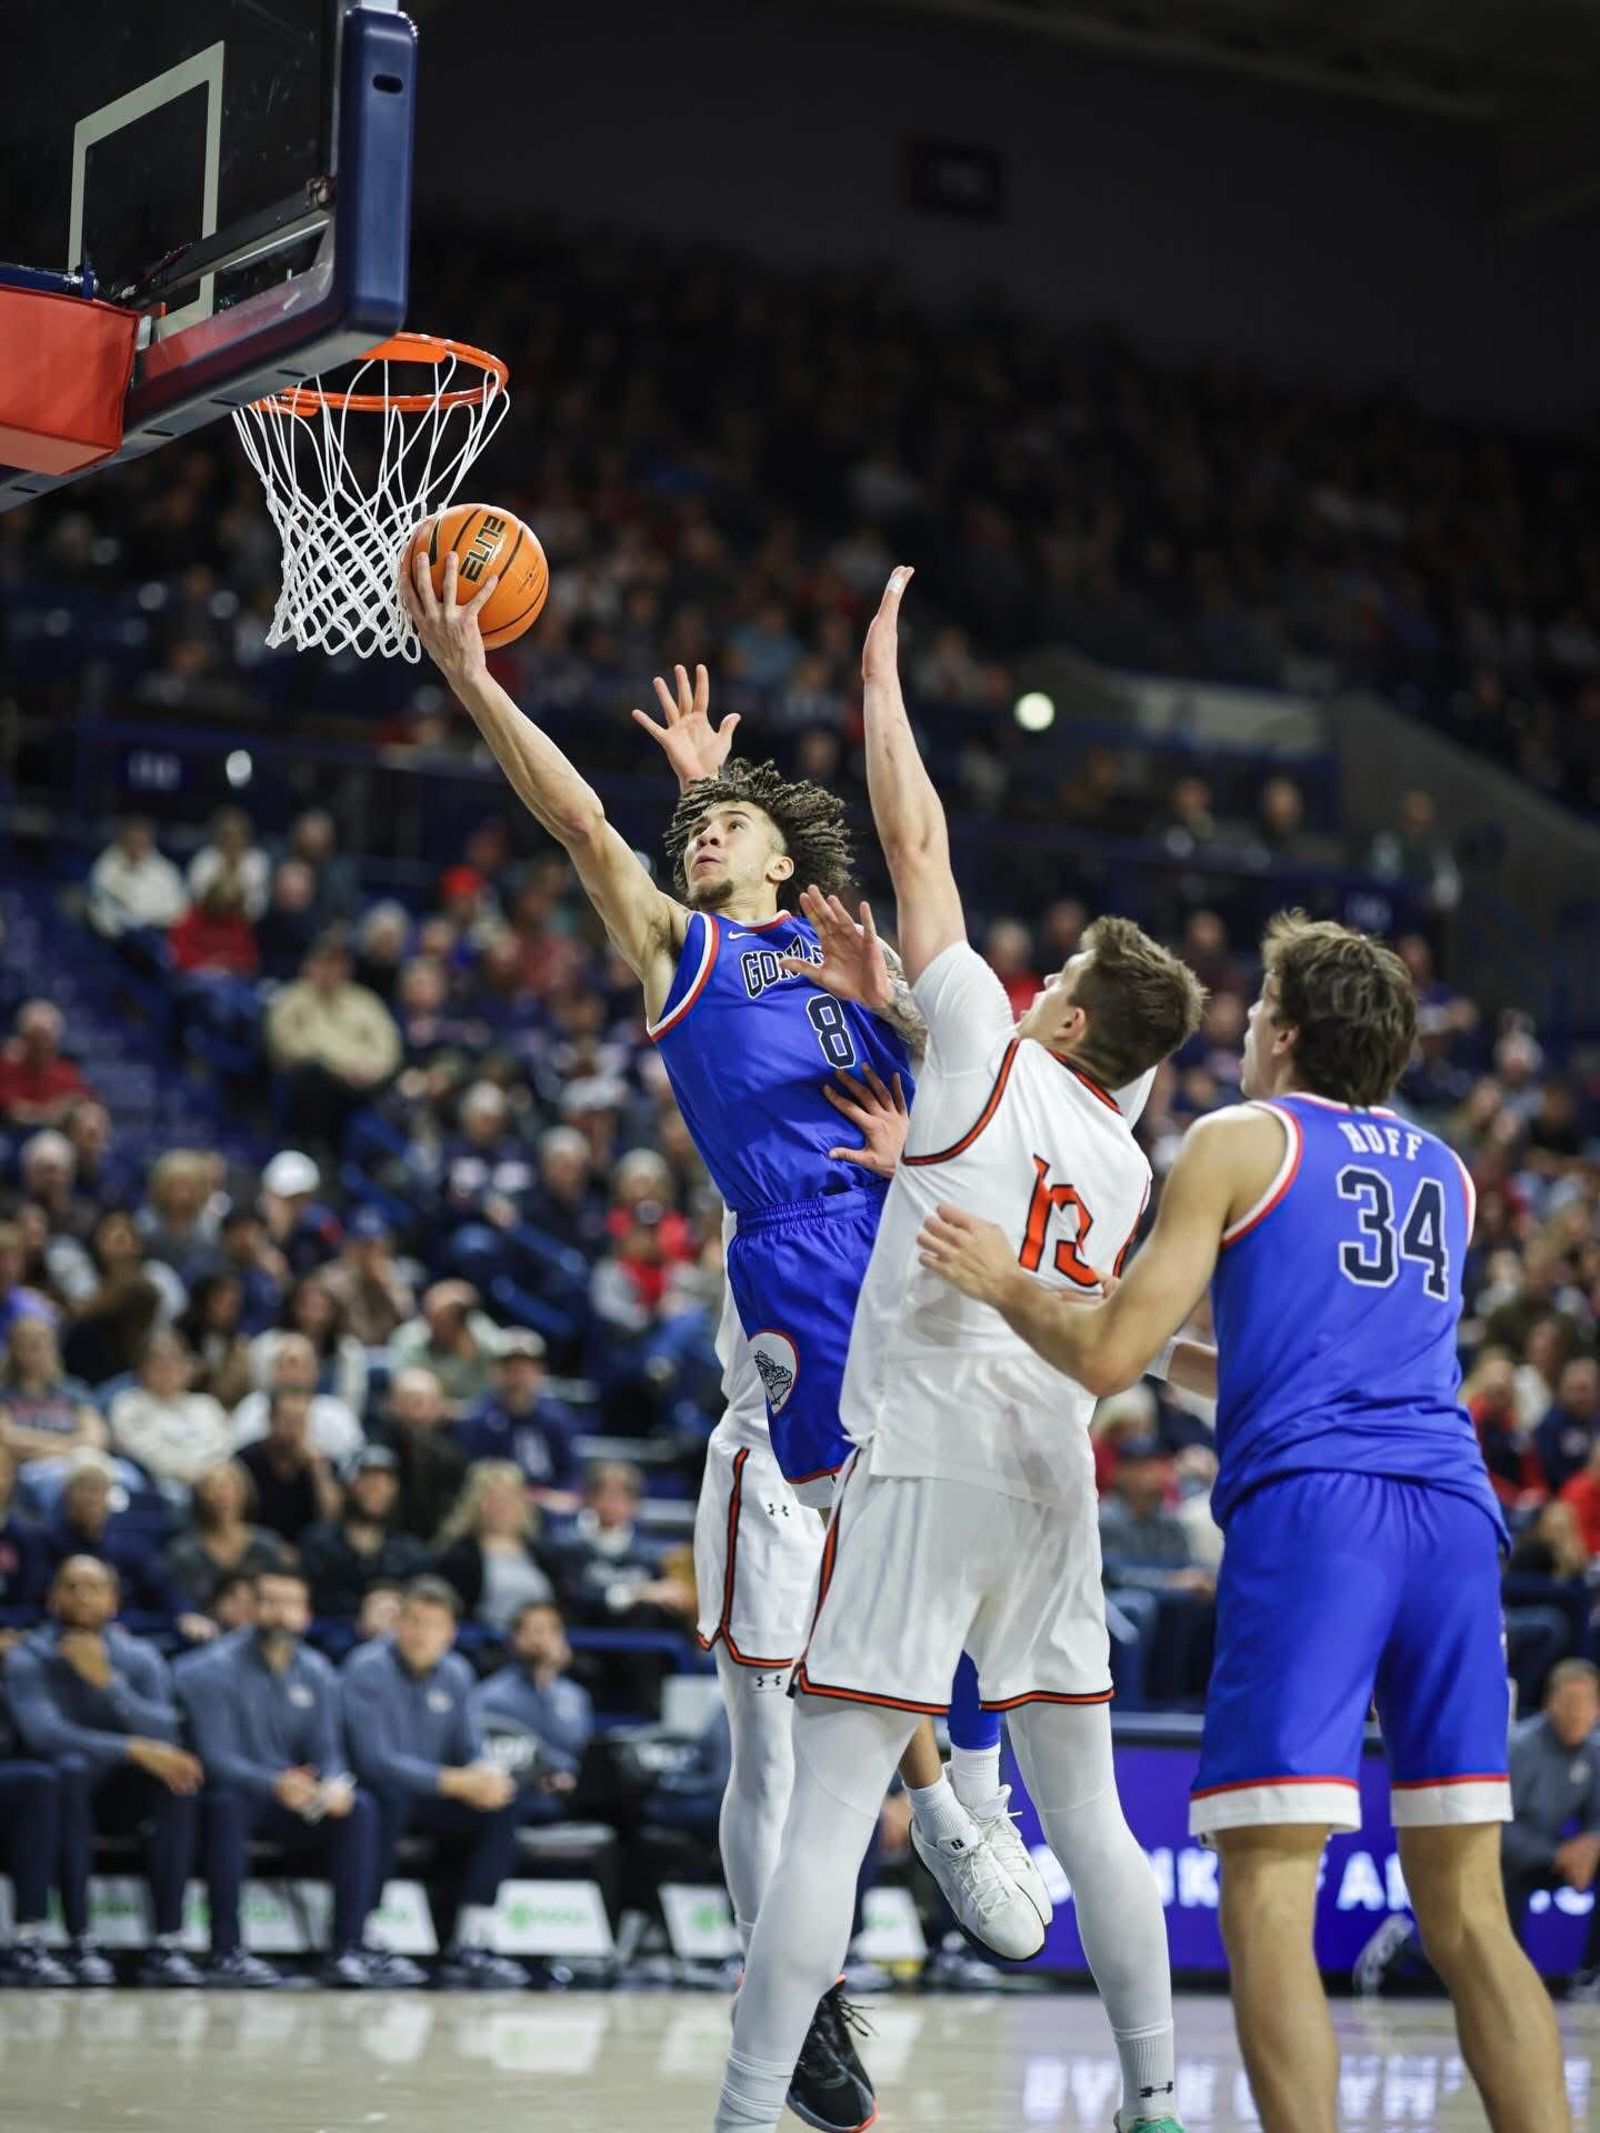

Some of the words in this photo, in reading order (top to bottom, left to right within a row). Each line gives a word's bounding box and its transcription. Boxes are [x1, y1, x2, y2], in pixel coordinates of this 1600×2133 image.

[459, 514, 507, 583] ELITE
[805, 993, 857, 1070] 8
[1337, 1121, 1423, 1162] HUFF
[1336, 1164, 1450, 1302] 34
